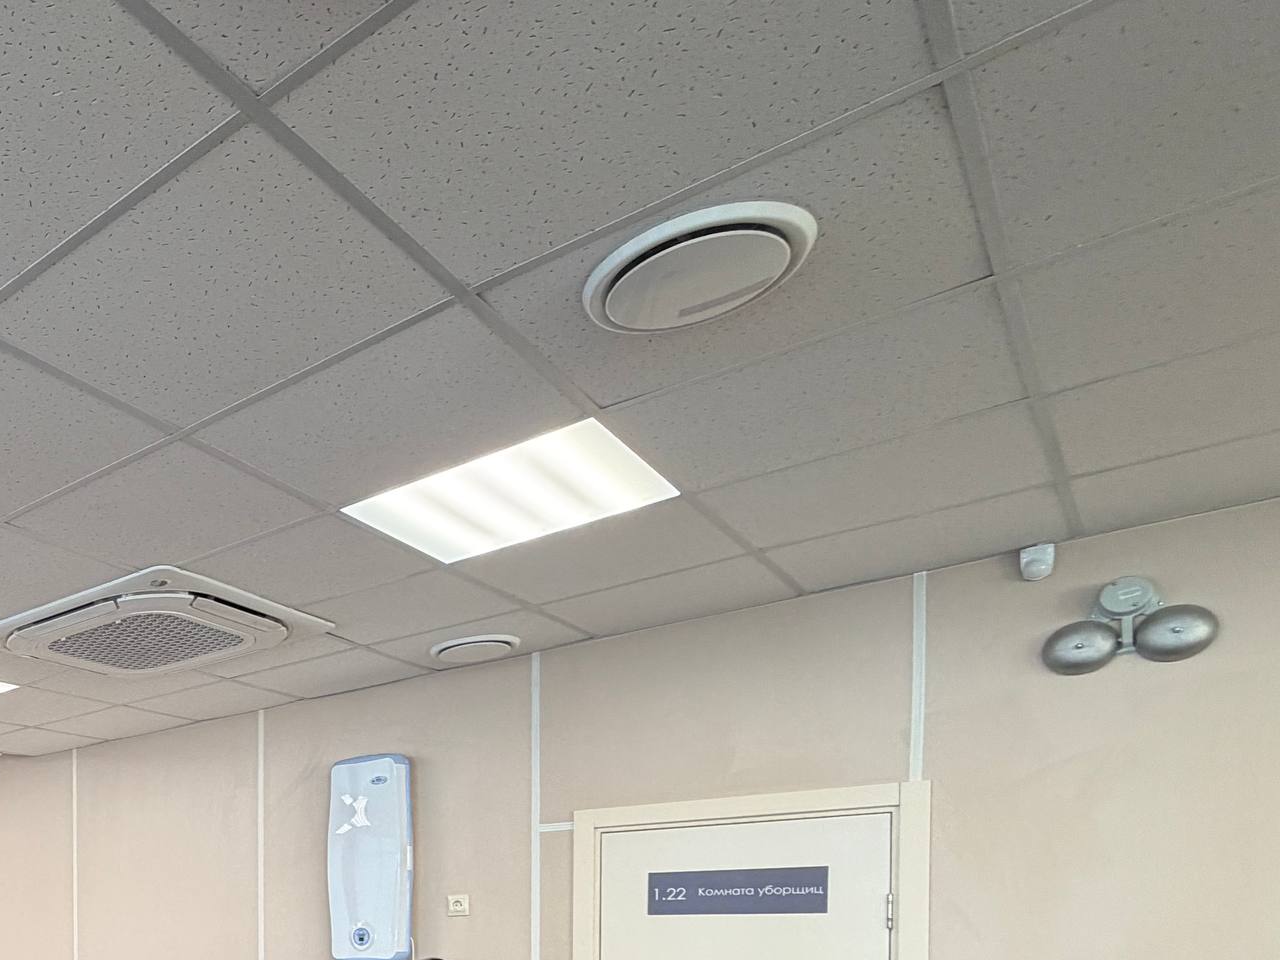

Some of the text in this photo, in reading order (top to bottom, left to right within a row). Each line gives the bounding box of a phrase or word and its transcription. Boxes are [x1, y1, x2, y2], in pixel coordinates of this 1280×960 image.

[653, 884, 824, 901] 1.22 Комната уборщиц
